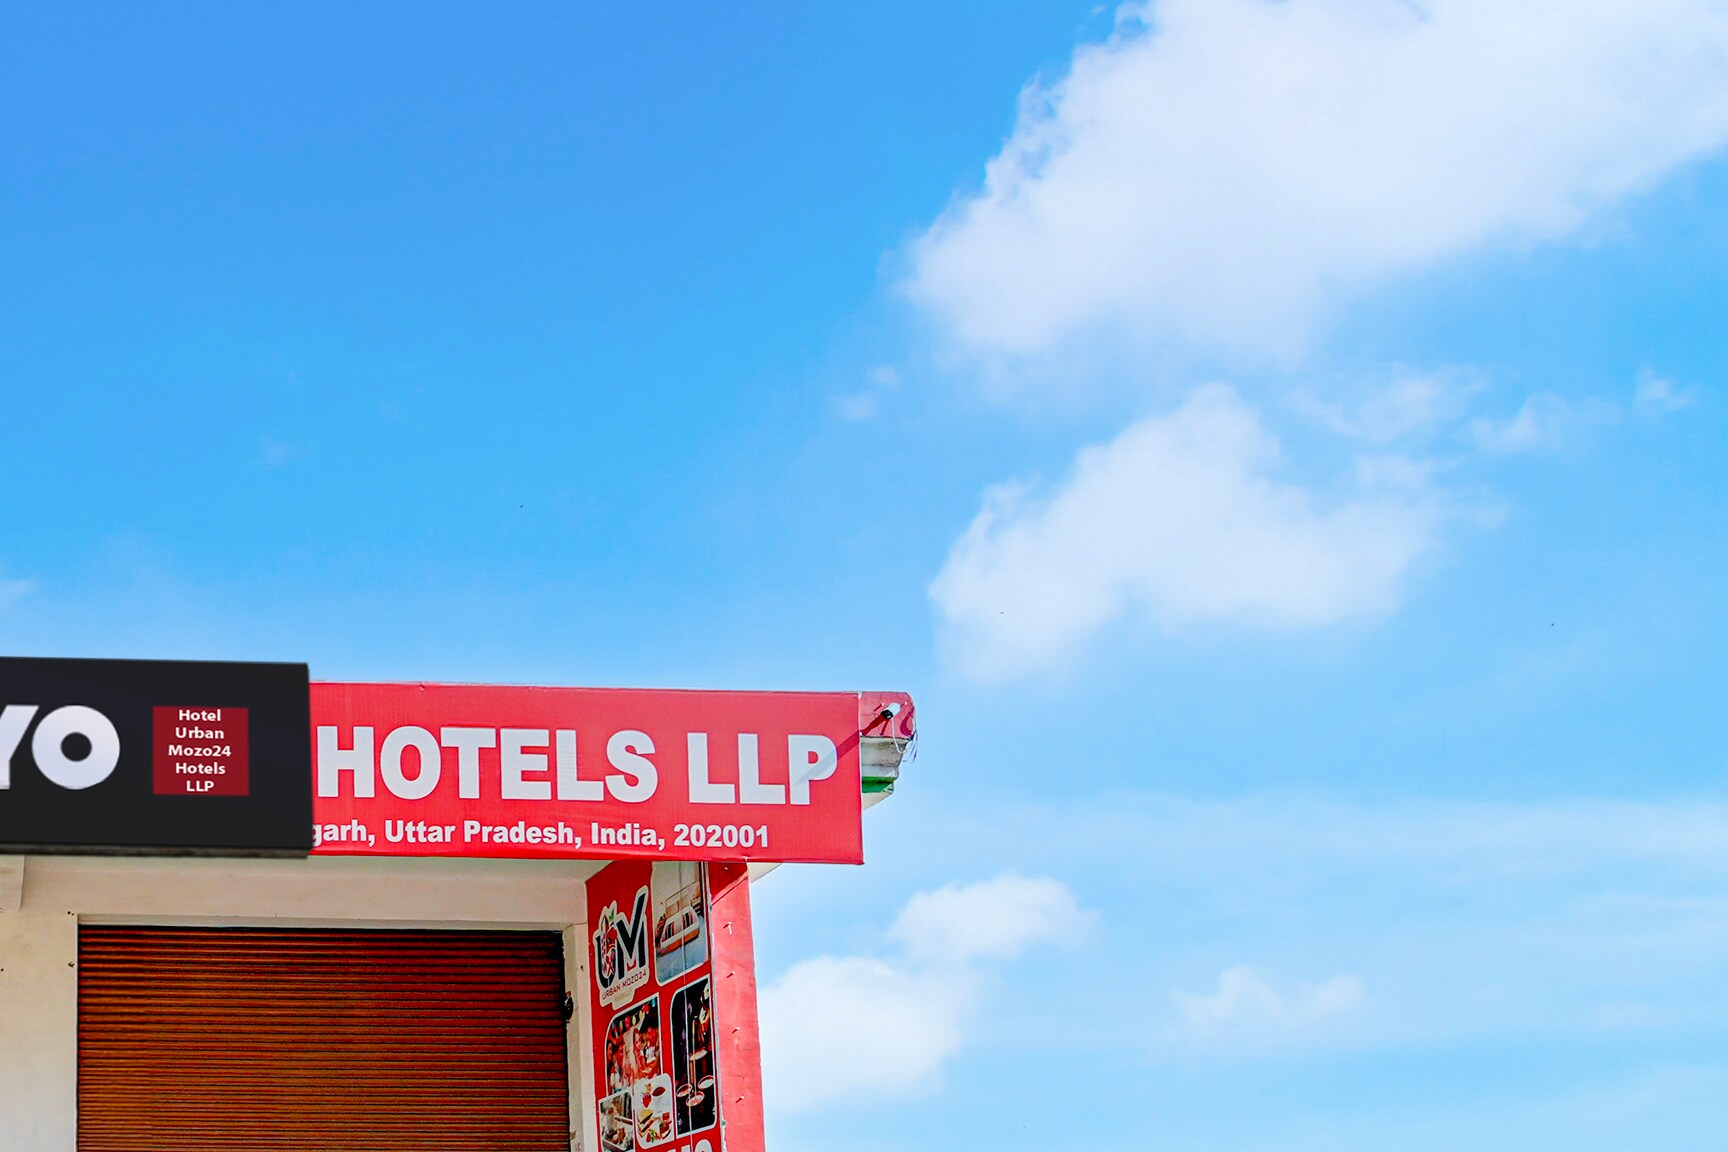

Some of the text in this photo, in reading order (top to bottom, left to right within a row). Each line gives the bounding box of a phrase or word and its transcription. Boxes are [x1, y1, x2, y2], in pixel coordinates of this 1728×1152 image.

[178, 708, 221, 721] Hotel
[175, 726, 224, 739] Urban
[168, 744, 232, 757] Mozo24
[175, 762, 226, 775] Hotels
[316, 725, 838, 805] HOTELS LLP
[186, 780, 215, 792] LLP
[385, 820, 456, 843] Uttar
[463, 820, 582, 849] Pradesh,
[591, 822, 665, 851] India,
[673, 824, 768, 847] 202001
